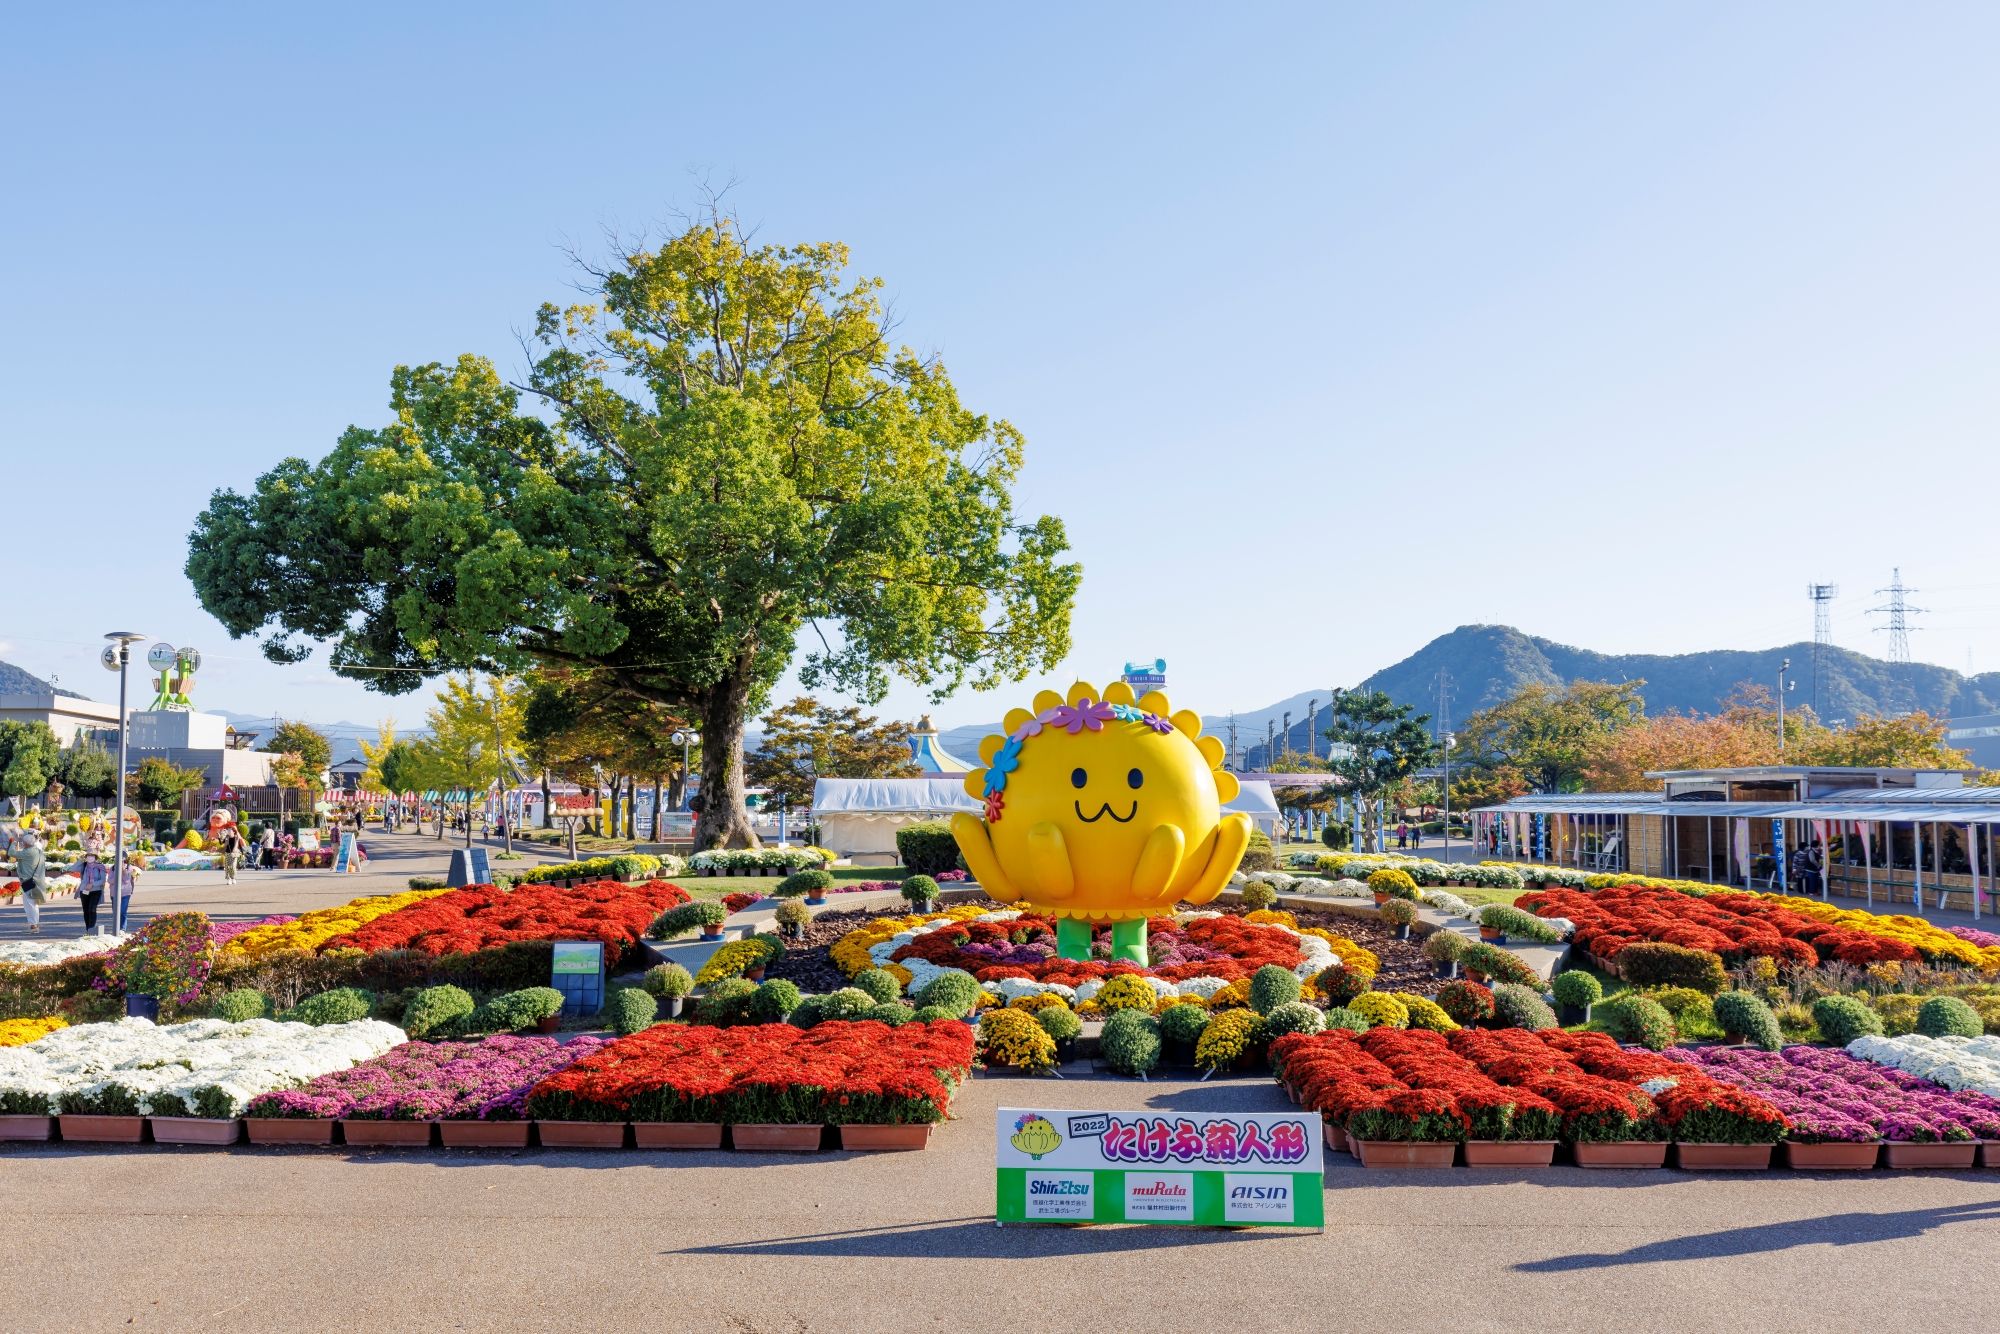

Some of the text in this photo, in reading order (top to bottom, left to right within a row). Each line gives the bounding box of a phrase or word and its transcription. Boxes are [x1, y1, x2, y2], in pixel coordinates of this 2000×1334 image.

[1073, 1119, 1105, 1132] 2022
[1102, 1119, 1307, 1163] たけふ菊人形
[1132, 1181, 1187, 1196] muRata
[1231, 1186, 1288, 1200] AISIN
